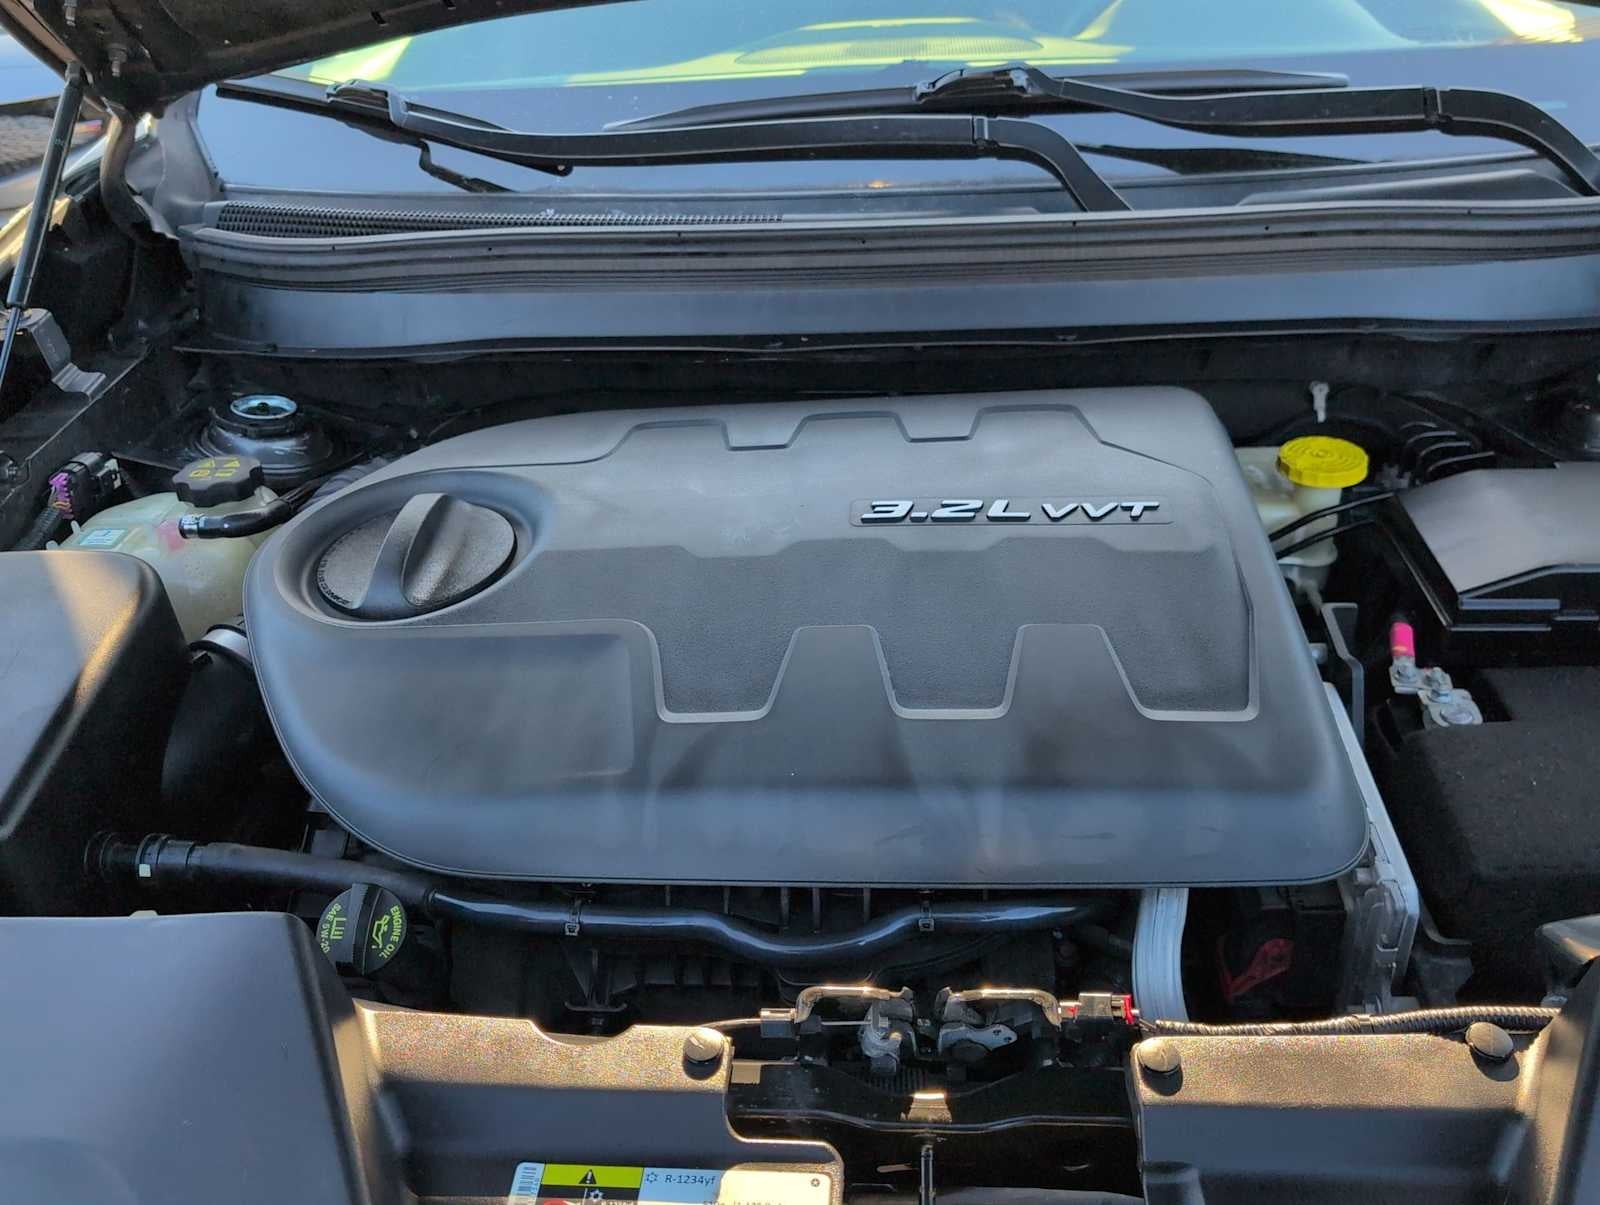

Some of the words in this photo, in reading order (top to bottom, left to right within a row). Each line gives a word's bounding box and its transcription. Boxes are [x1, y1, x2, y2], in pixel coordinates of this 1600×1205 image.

[861, 499, 1031, 523] 3.2L
[1041, 501, 1160, 522] VVT
[325, 903, 342, 922] SAE
[390, 905, 402, 942] ENGINE
[379, 944, 395, 959] OIL
[664, 1174, 716, 1187] R-1234yf
